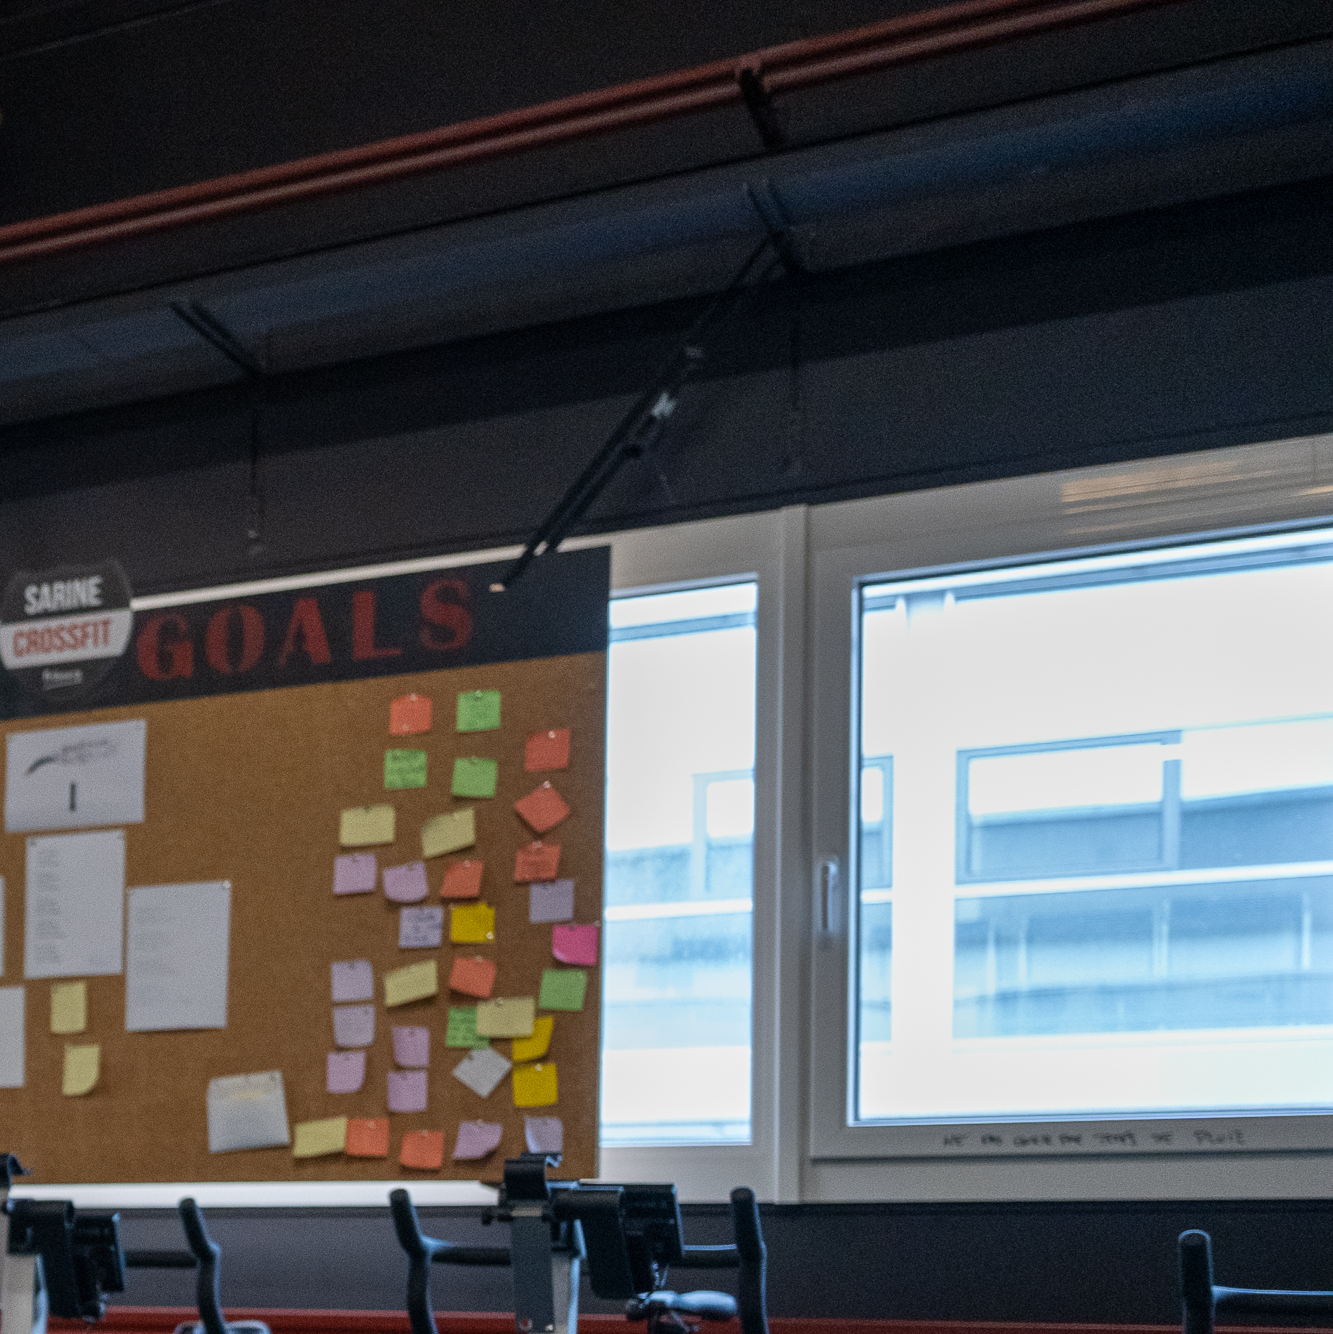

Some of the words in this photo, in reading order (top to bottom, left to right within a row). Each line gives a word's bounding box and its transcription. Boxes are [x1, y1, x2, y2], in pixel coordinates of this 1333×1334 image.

[23, 576, 103, 615] SARINE
[12, 618, 111, 659] CROSSFIT
[136, 578, 474, 681] GOALS
